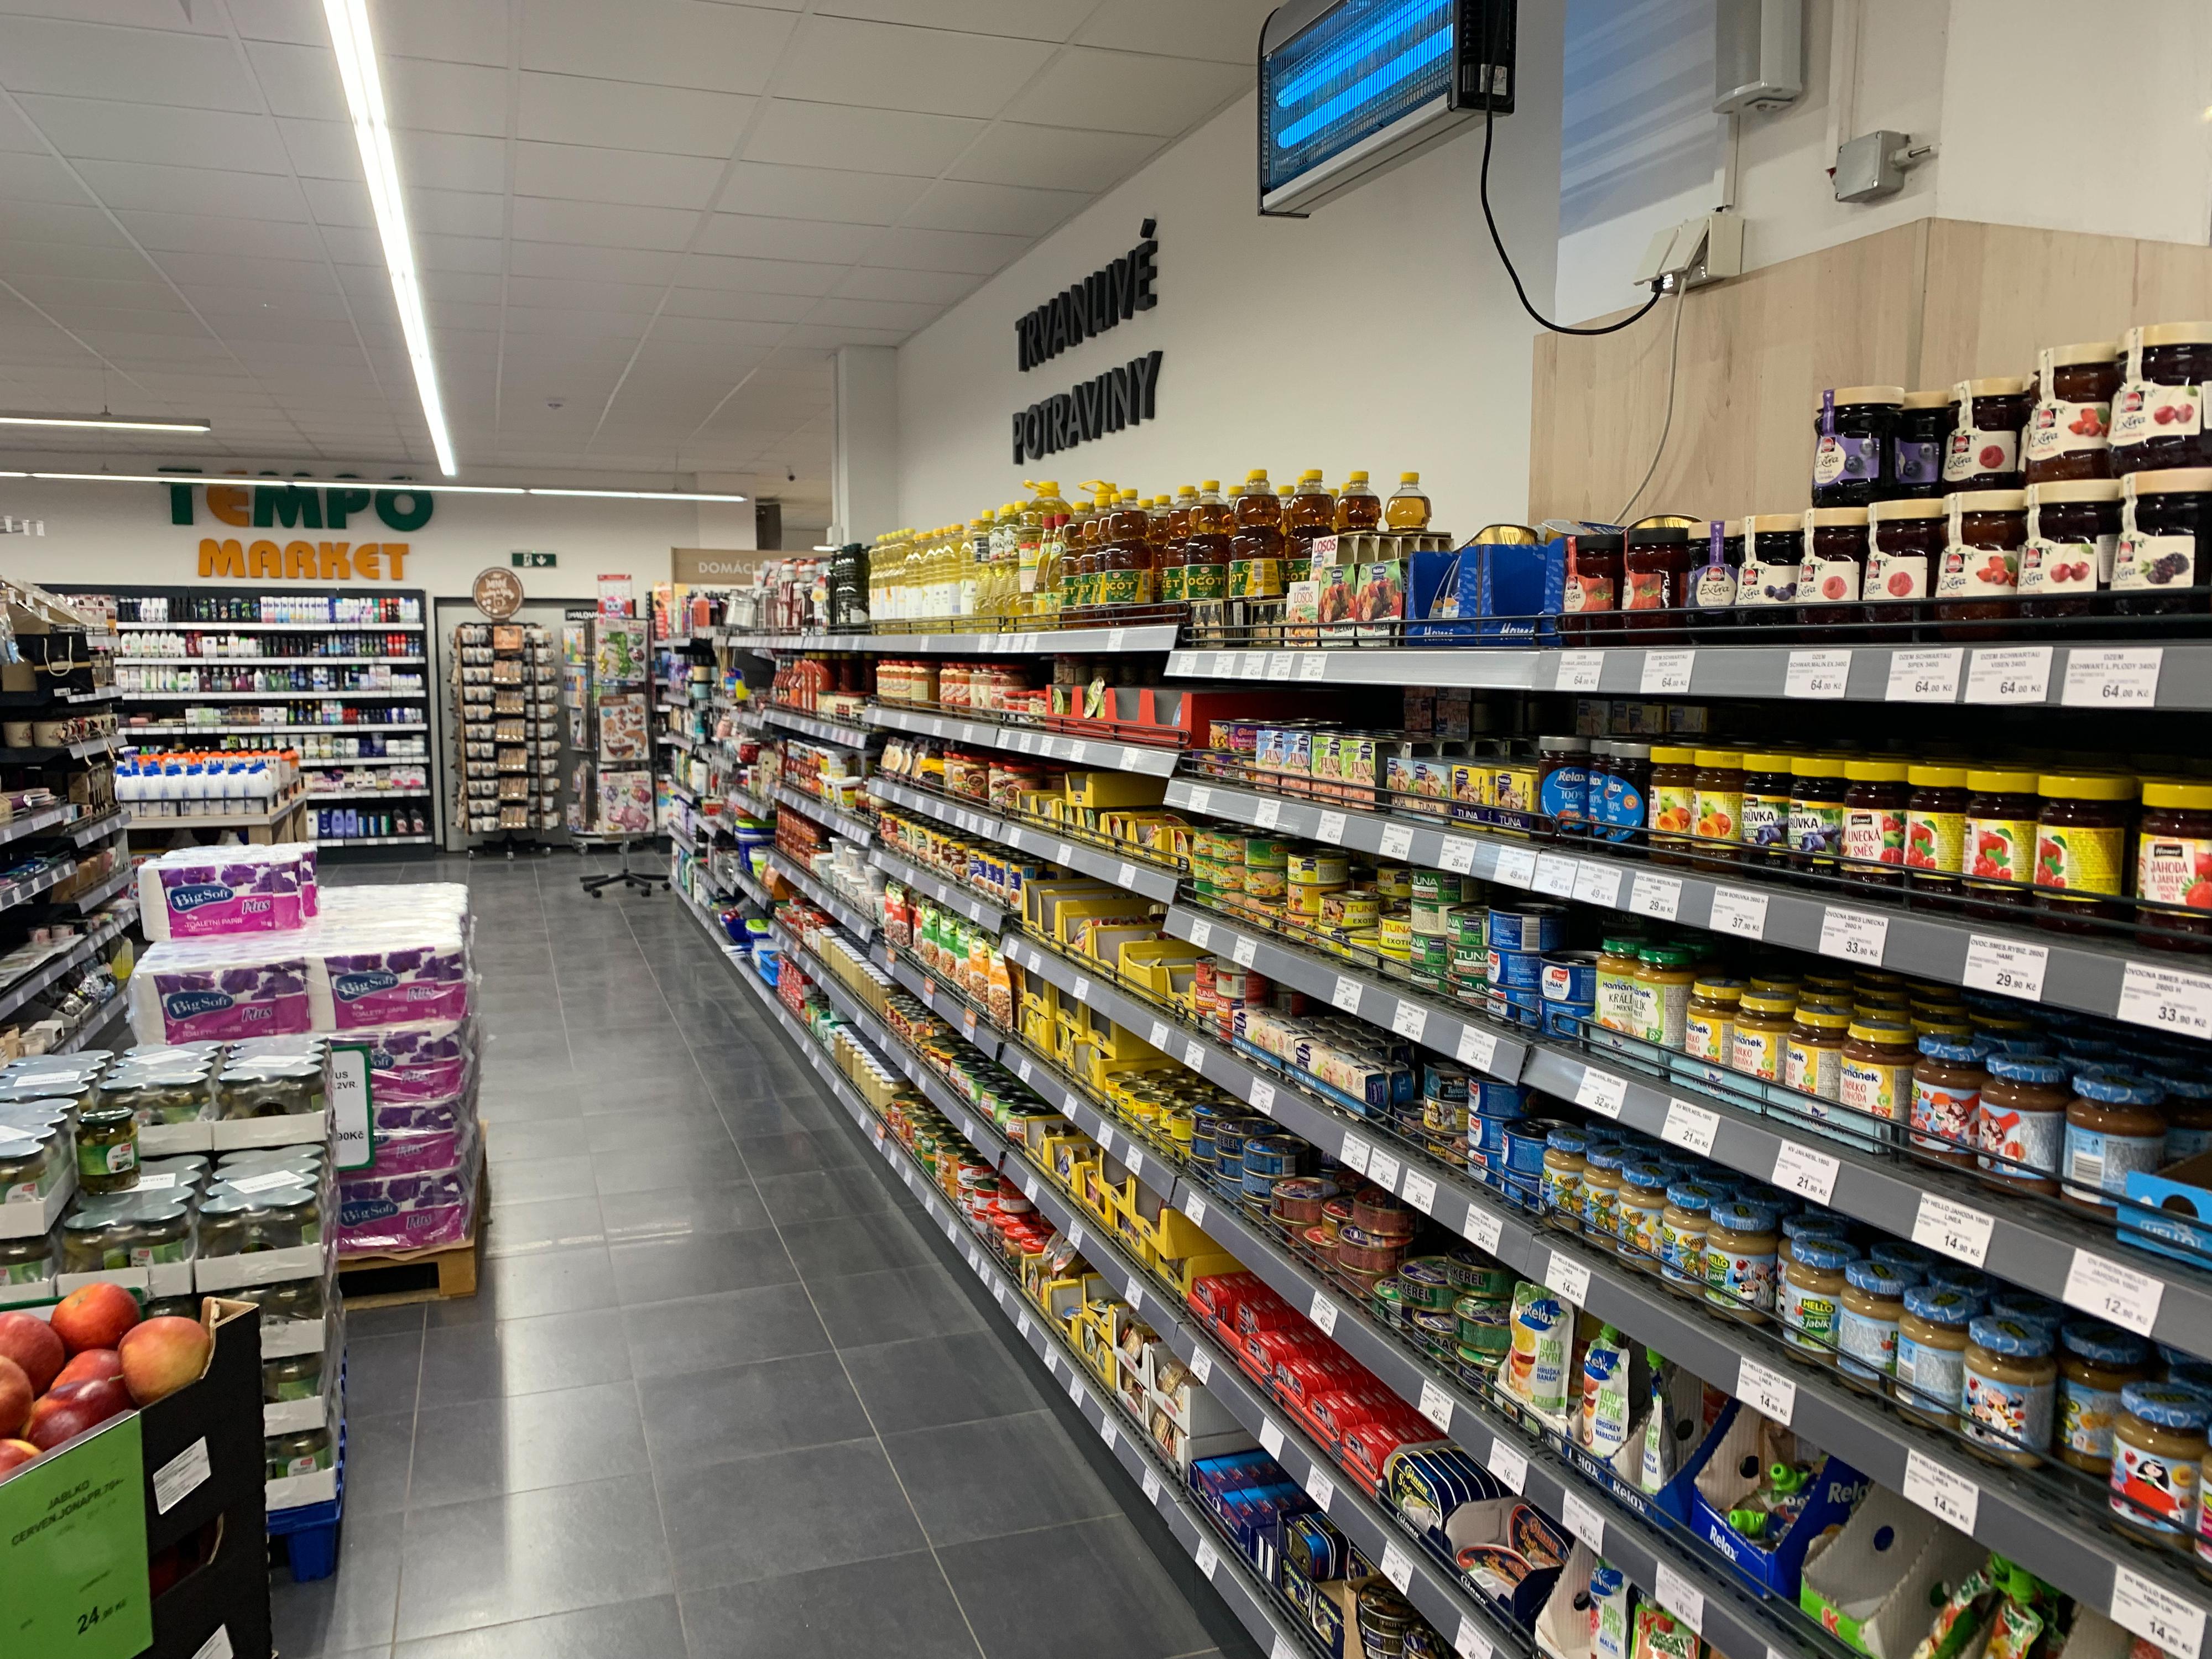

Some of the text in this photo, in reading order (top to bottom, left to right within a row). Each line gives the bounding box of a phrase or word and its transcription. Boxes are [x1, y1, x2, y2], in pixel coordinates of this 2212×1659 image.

[1015, 218, 1158, 372] TRVANLIVÉ
[1013, 350, 1163, 465] POTRAVINY
[158, 468, 434, 532] TEMPO
[1314, 539, 1336, 552] LOSOS
[197, 538, 410, 581] MARKET
[1188, 577, 1223, 586] OCOT
[1700, 583, 1730, 596] Extra
[1294, 592, 1313, 603] LOSOS
[1290, 753, 1309, 765] TUNA
[1320, 757, 1340, 770] TUNA
[1350, 761, 1373, 774] TUNA
[1559, 771, 1585, 781] Relax
[1561, 790, 1585, 800] 100%
[1418, 802, 1438, 813] TUNA
[1457, 808, 1478, 820] TUNA
[1499, 815, 1521, 827] TUNA
[1848, 827, 1881, 842] LINECKÁ
[1854, 843, 1874, 857] SMĚS
[2151, 860, 2188, 873] JAHODA
[1413, 875, 1438, 886] TUNA
[242, 899, 270, 915] Plus
[1349, 905, 1378, 913] TUNA
[1848, 914, 1863, 923] SMES
[1863, 917, 1885, 927] LINECKA
[1384, 922, 1412, 933] TUNA
[1457, 950, 1488, 961] TUNA
[2026, 982, 2036, 992] Kč
[1197, 989, 1216, 998] TUNA
[241, 1006, 273, 1022] Plus
[335, 1081, 358, 1089] 2VR.
[1702, 1140, 1709, 1149] Kč
[1819, 1188, 1827, 1197] Kč
[1931, 1200, 1950, 1212] HELLO
[1944, 1214, 1961, 1224] LINEA
[1970, 1248, 1980, 1258] Kč
[1708, 1253, 1729, 1268] HELLO
[1803, 1298, 1834, 1314] HELLO
[1525, 1302, 1558, 1327] Relax
[1537, 1366, 1561, 1376] HRUŠKA
[1748, 1363, 1762, 1374] HELLO
[1537, 1373, 1557, 1383] BANÁN
[1780, 1407, 1787, 1417] Kč
[1595, 1417, 1621, 1432] BROSKEV
[1613, 1480, 1647, 1514] Relax
[1827, 1480, 1869, 1504] Rela
[1710, 1525, 1739, 1562] Relax
